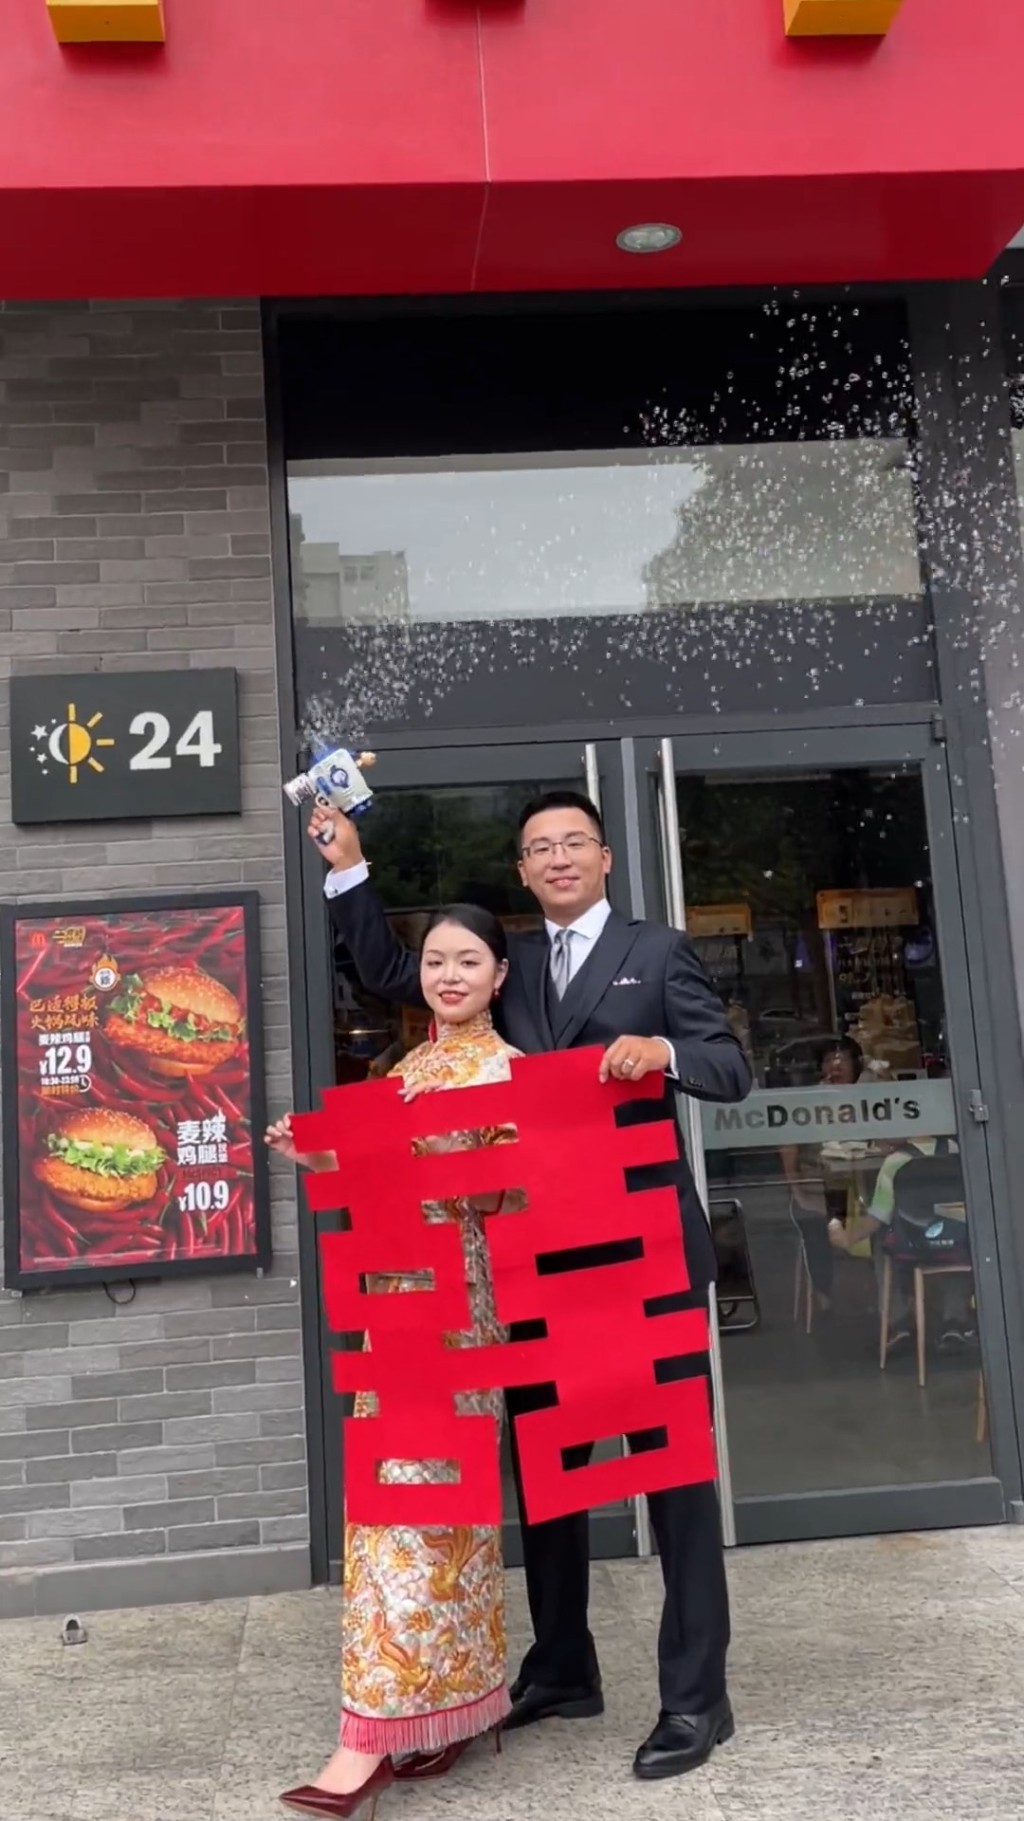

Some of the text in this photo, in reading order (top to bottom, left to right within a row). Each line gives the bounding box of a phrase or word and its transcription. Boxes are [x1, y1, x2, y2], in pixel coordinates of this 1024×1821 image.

[128, 710, 222, 770] 24
[31, 1011, 100, 1031] 火锅风味
[39, 1045, 92, 1075] ¥12.9
[177, 1110, 228, 1145] 麦辣
[714, 1096, 921, 1131] McDonald's
[178, 1180, 229, 1212] ¥10.9
